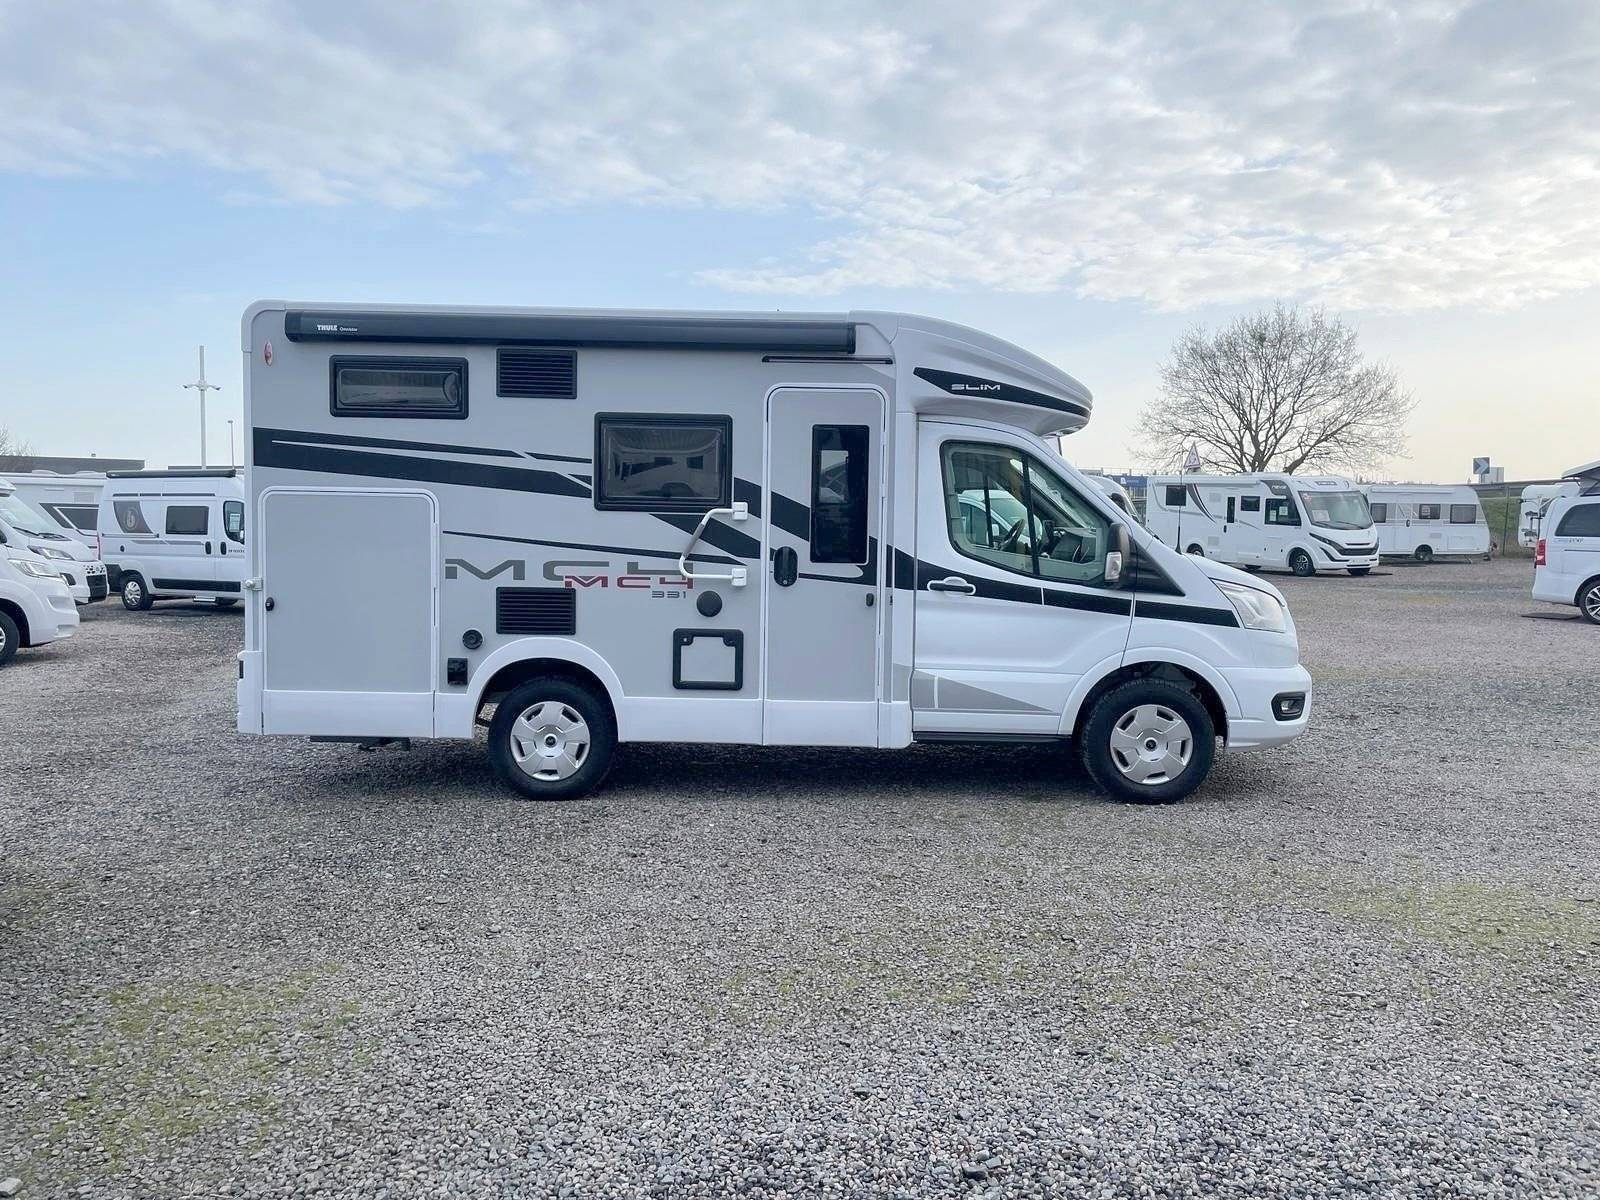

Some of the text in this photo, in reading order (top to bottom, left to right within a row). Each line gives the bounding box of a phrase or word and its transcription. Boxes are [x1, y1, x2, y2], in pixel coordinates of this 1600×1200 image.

[951, 383, 1001, 391] SLIM
[564, 575, 694, 590] MC4
[651, 590, 687, 599] 331
